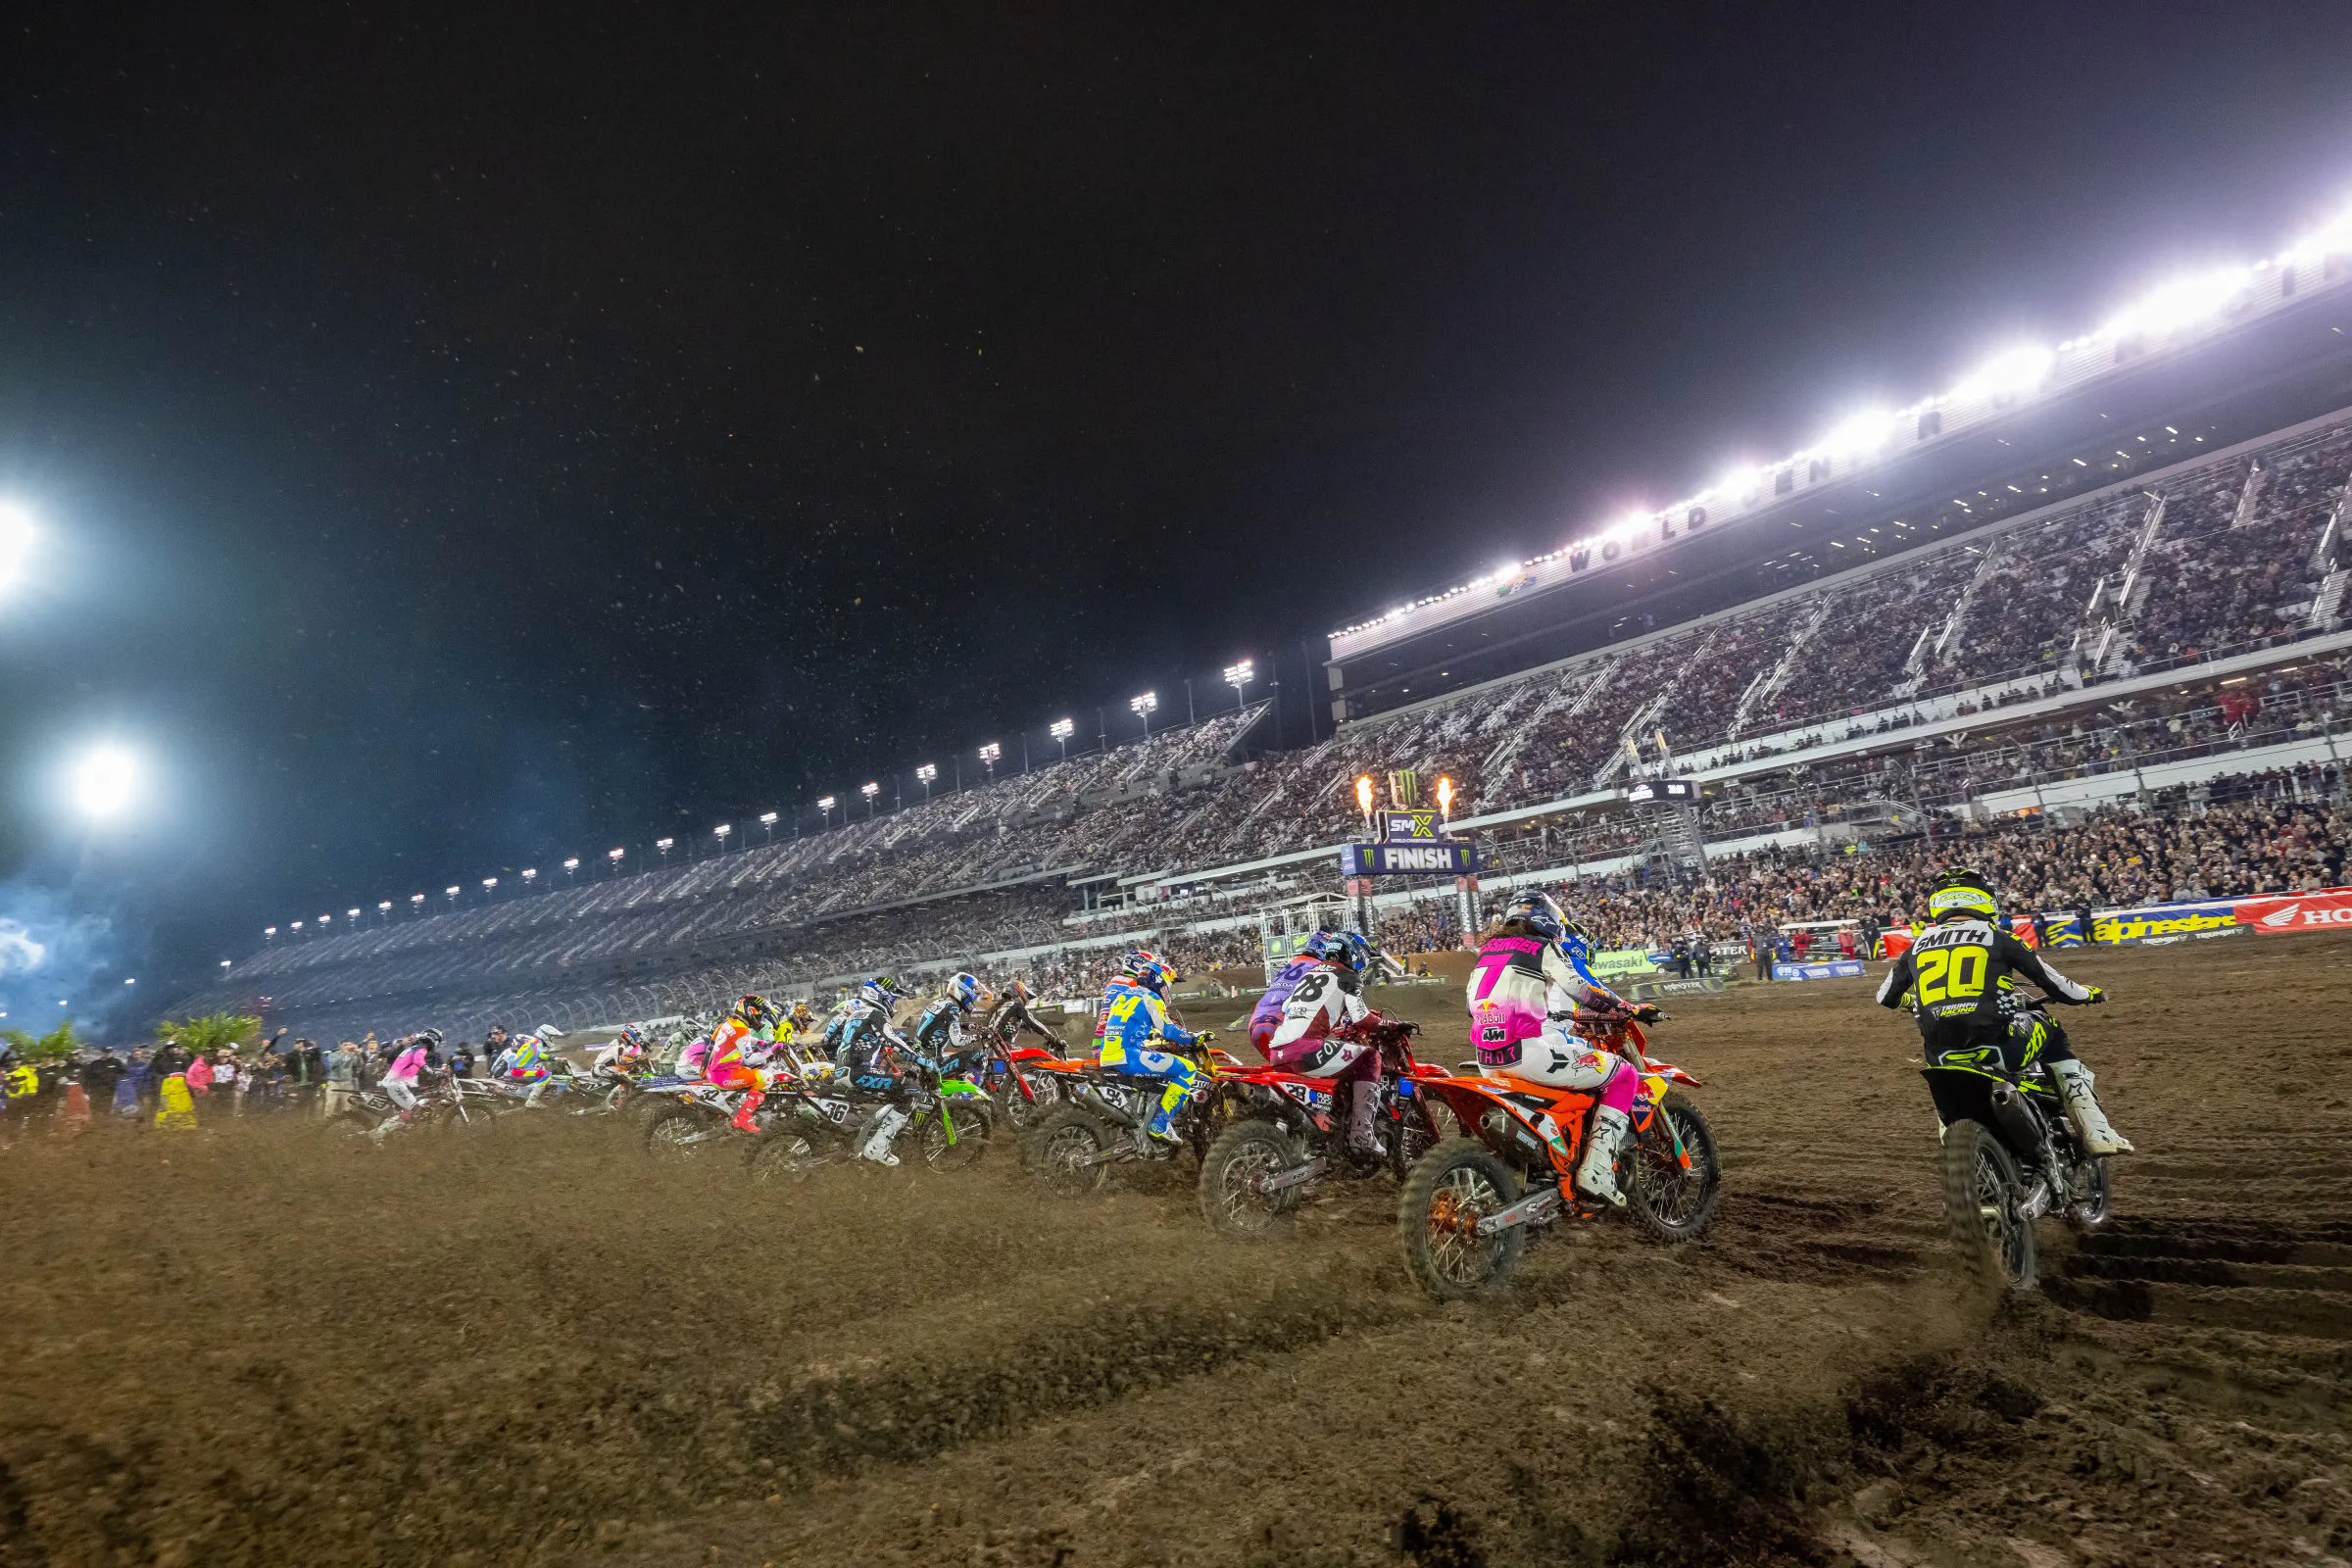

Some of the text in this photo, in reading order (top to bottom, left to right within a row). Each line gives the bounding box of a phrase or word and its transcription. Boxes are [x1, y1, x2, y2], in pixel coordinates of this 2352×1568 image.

[1390, 814, 1434, 838] SMX
[1384, 848, 1452, 870] FINISH
[1916, 929, 1988, 953] SMITH
[1591, 956, 1642, 970] awasaki
[1475, 954, 1513, 1000] 7
[1916, 946, 1988, 1006] 20
[1291, 974, 1330, 1003] 28
[1940, 1007, 1976, 1016] RACING
[1941, 1002, 1979, 1011] TRIUMPH
[1483, 1027, 1505, 1041] KTM
[856, 1074, 894, 1090] FXR
[701, 1089, 719, 1102] 32
[1106, 1088, 1124, 1108] 94
[825, 1102, 850, 1122] 36
